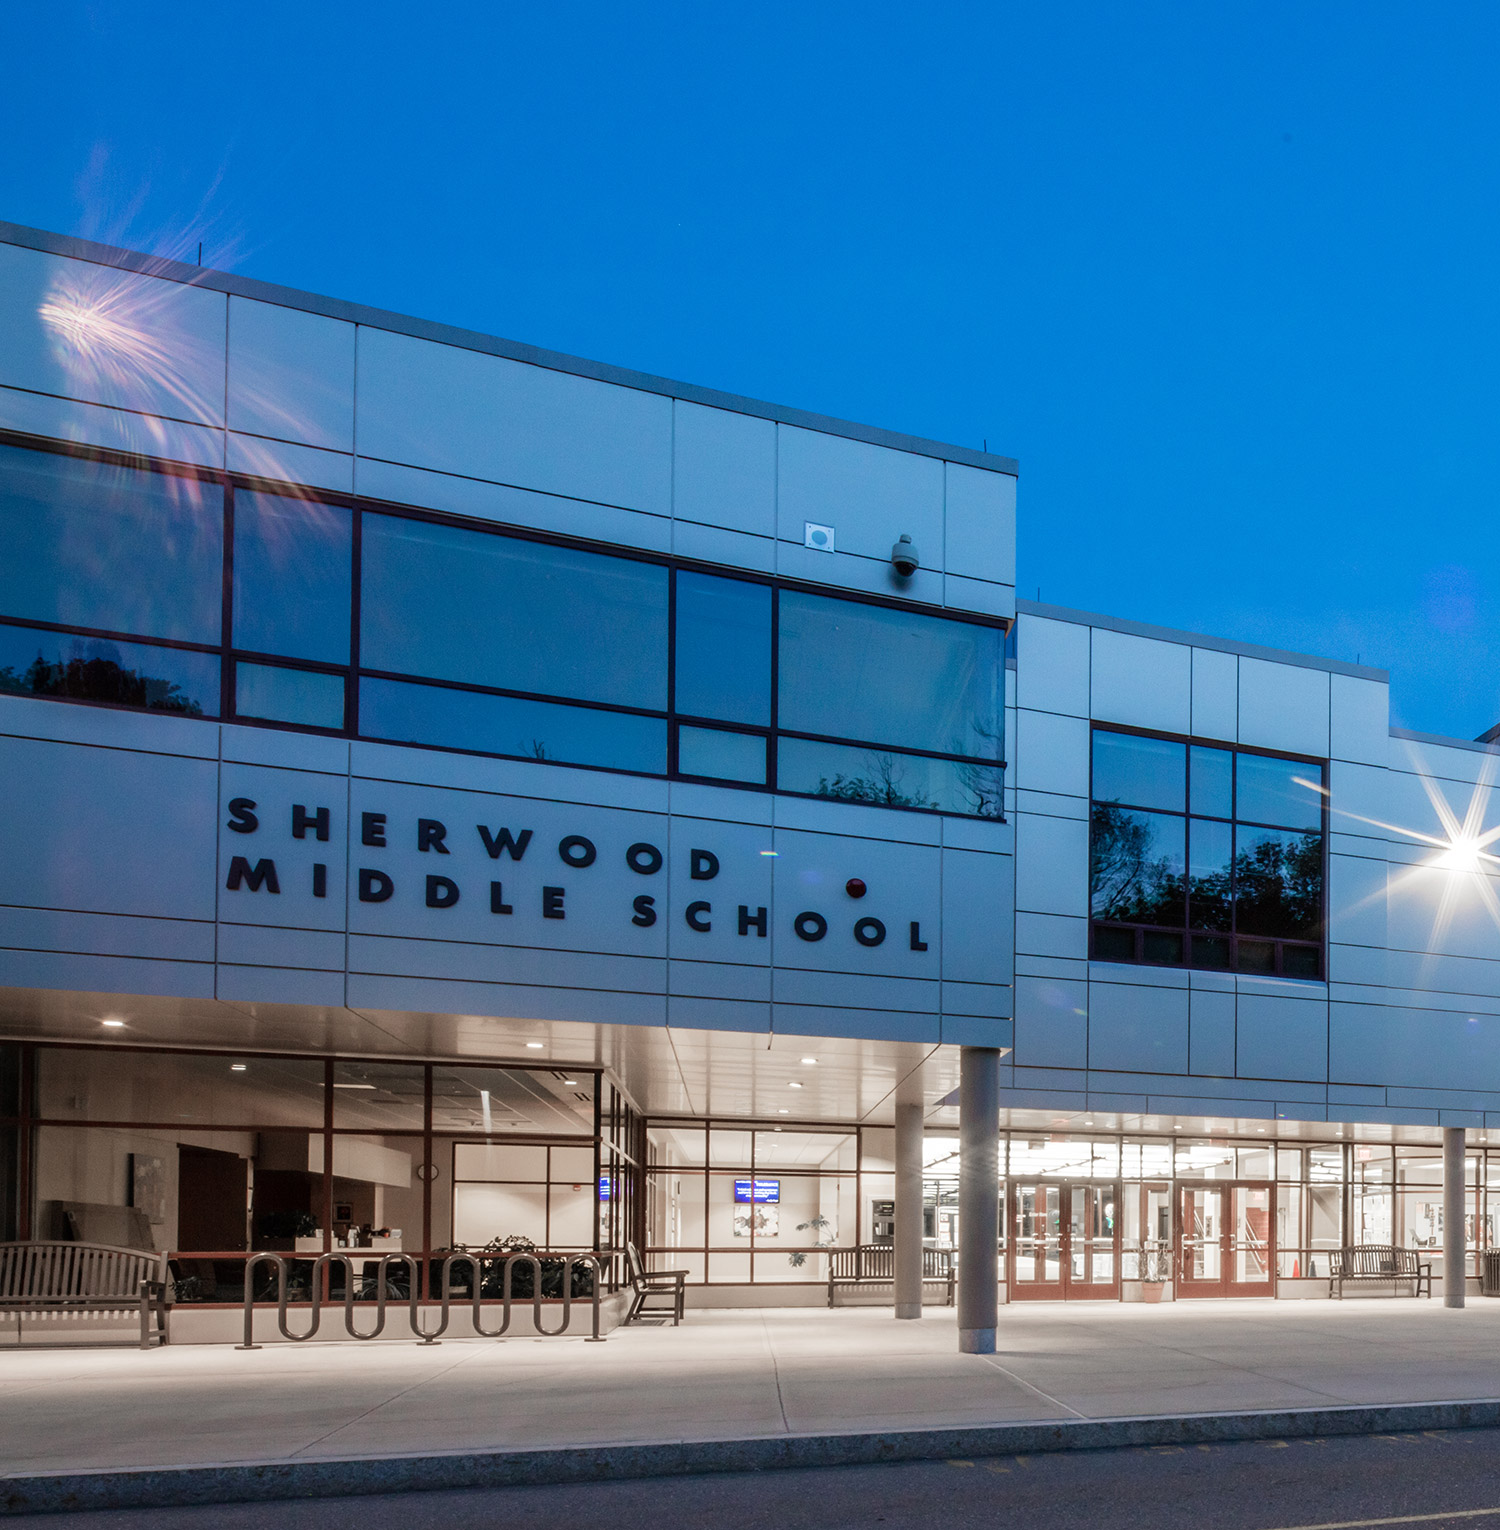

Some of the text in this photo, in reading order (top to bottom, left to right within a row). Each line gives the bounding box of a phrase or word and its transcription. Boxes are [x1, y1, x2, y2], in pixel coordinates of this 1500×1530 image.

[226, 797, 720, 881] SHERWOOD
[225, 855, 929, 952] MIDDLE SCHOOL
